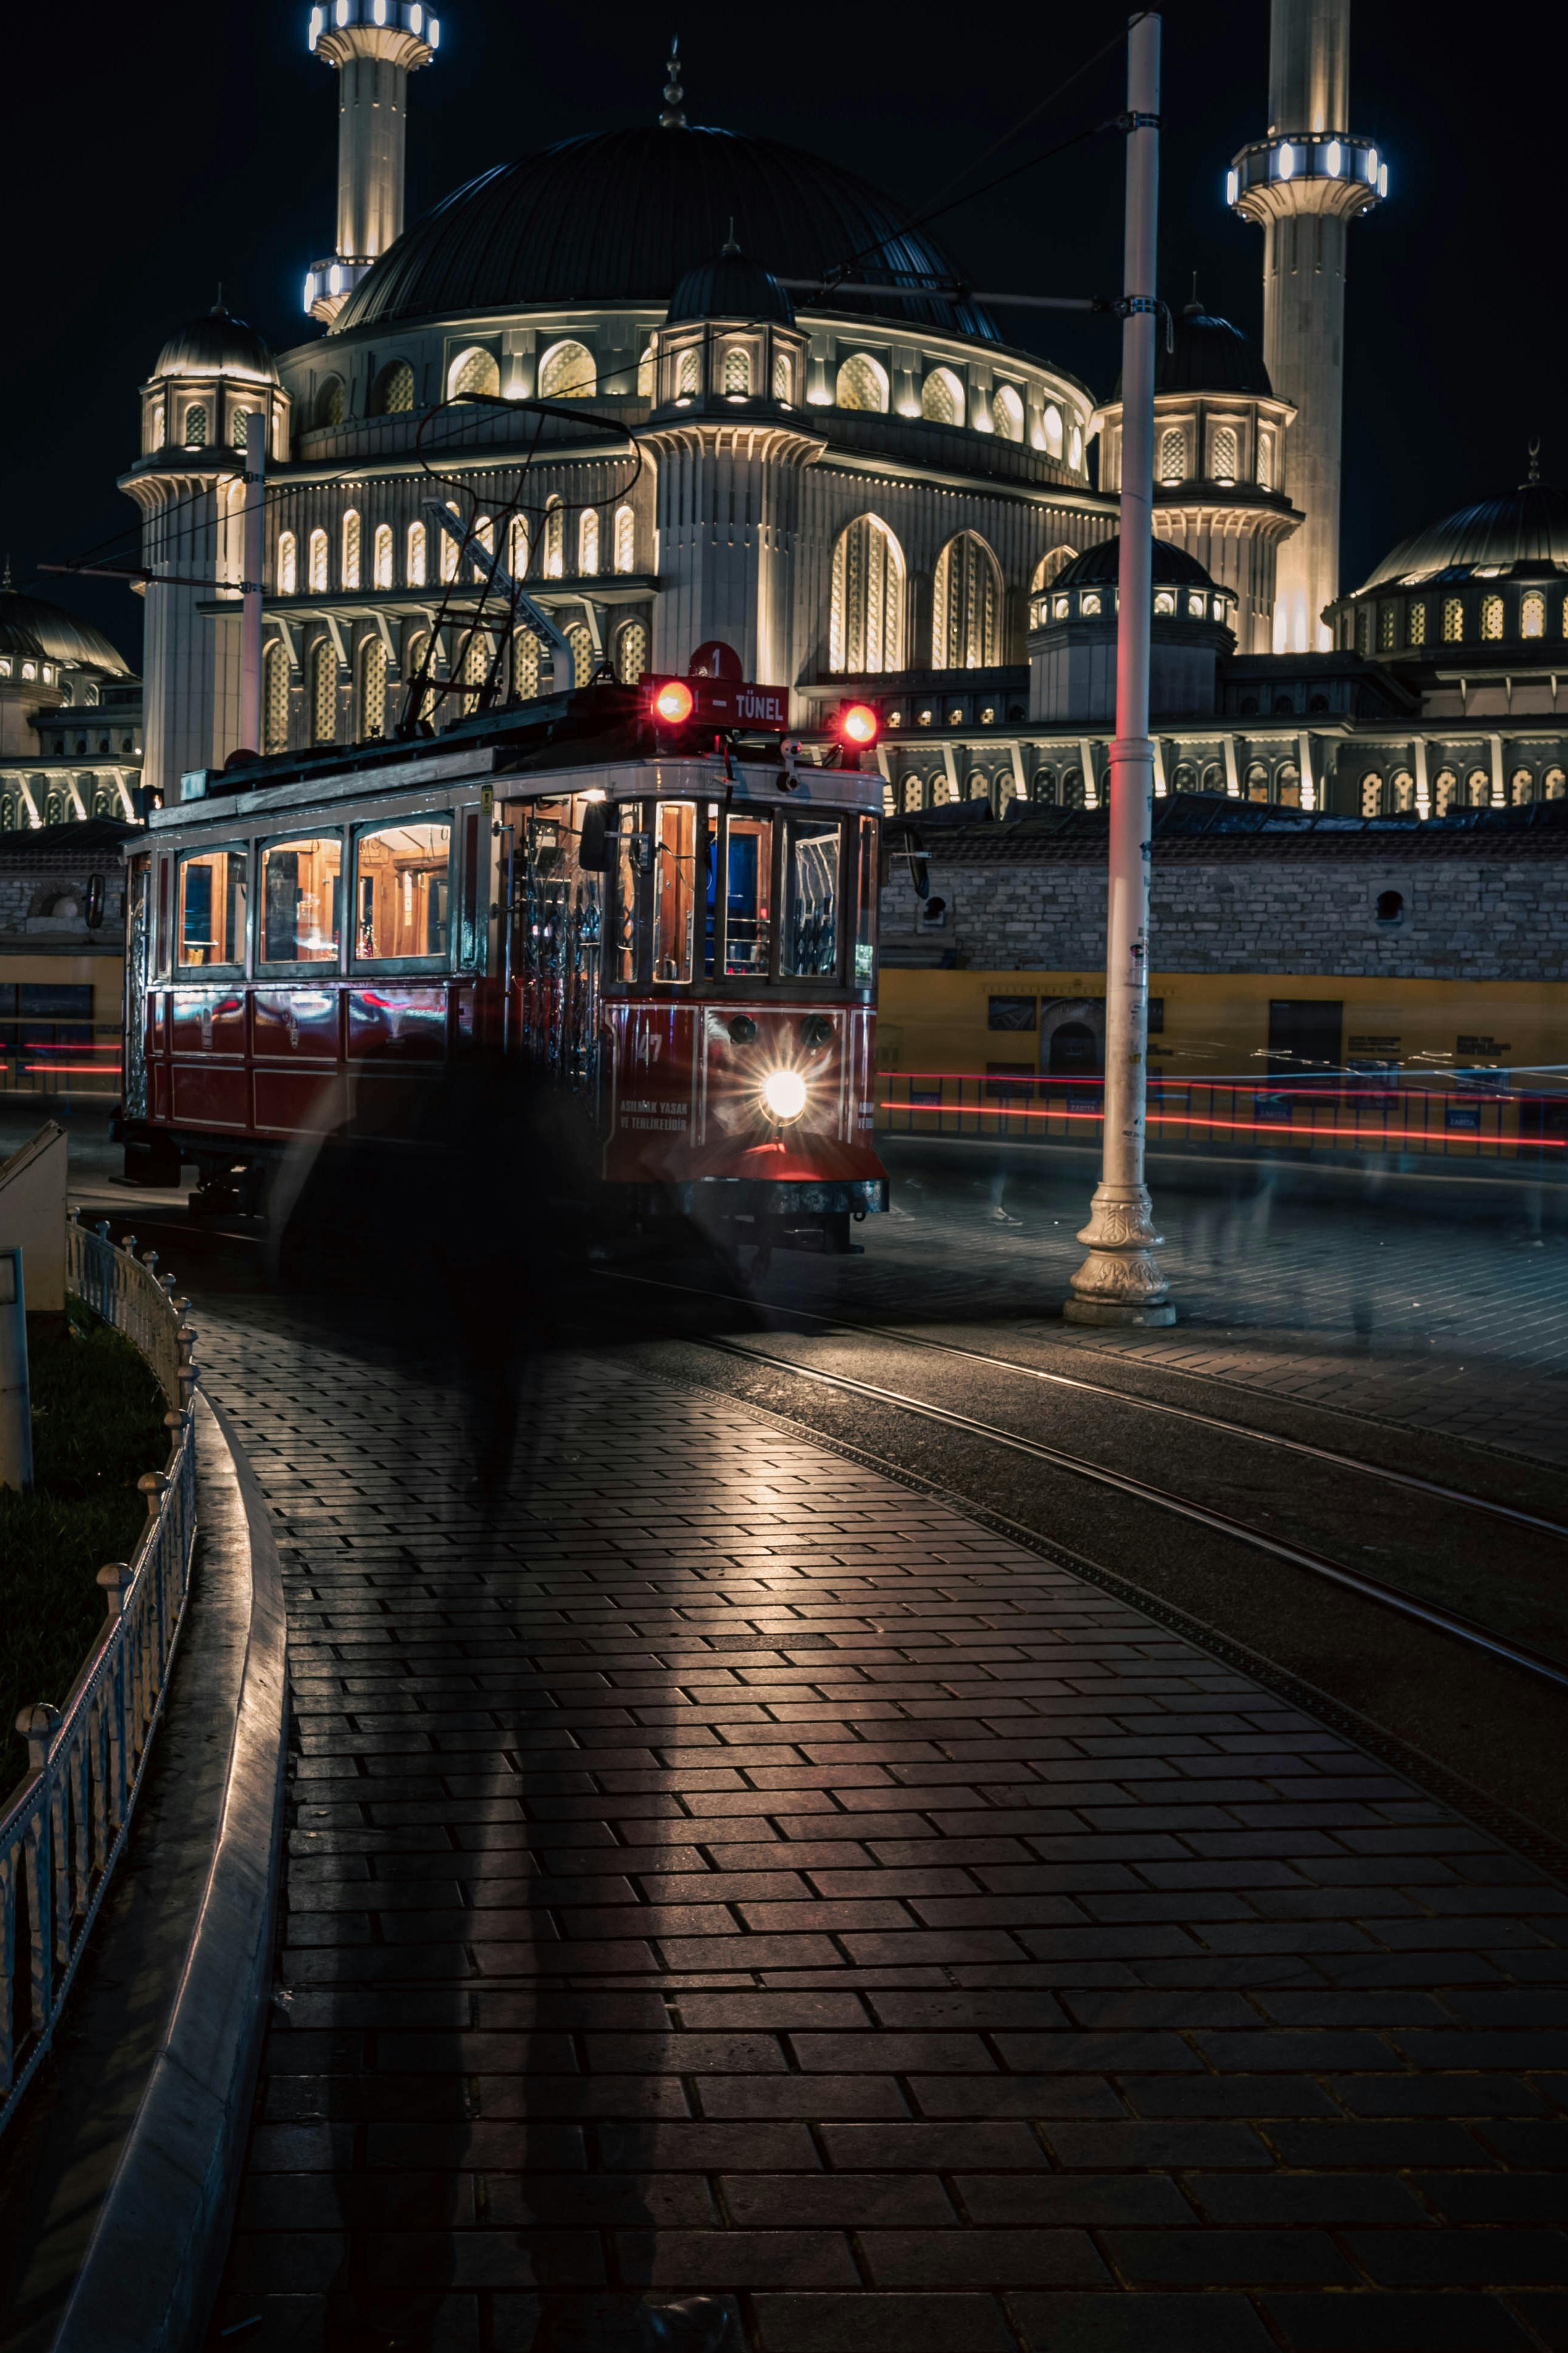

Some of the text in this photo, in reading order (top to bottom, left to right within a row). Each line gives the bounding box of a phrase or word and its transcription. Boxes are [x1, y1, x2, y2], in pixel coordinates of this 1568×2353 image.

[712, 648, 720, 677] 1
[736, 689, 784, 722] TÜNEL
[638, 1033, 663, 1063] 47
[621, 1099, 688, 1115] ASILMAK YASAK
[621, 1116, 630, 1129] VE
